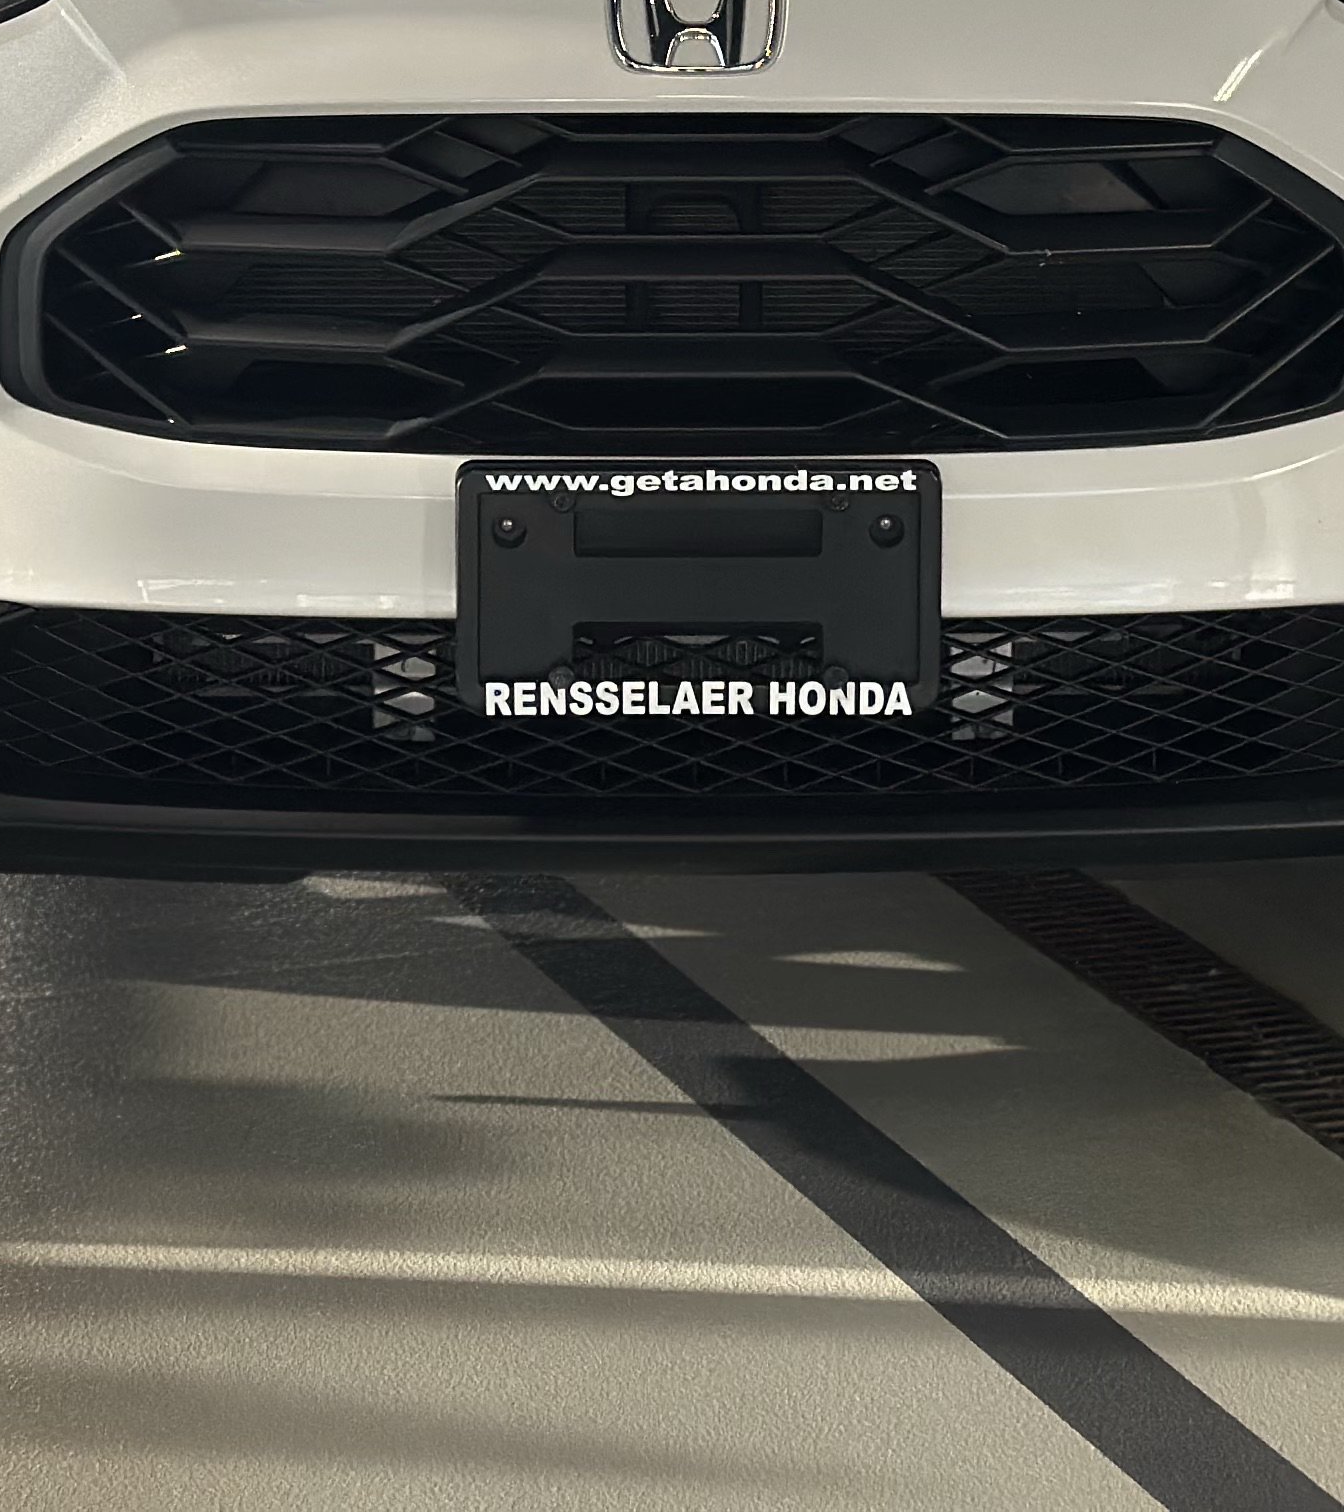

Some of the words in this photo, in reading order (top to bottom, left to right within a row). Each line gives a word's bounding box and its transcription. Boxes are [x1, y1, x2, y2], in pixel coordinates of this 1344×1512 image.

[485, 469, 917, 497] www.getahonda.net
[485, 680, 755, 716] RENSSELAER
[769, 680, 913, 716] HONDA
